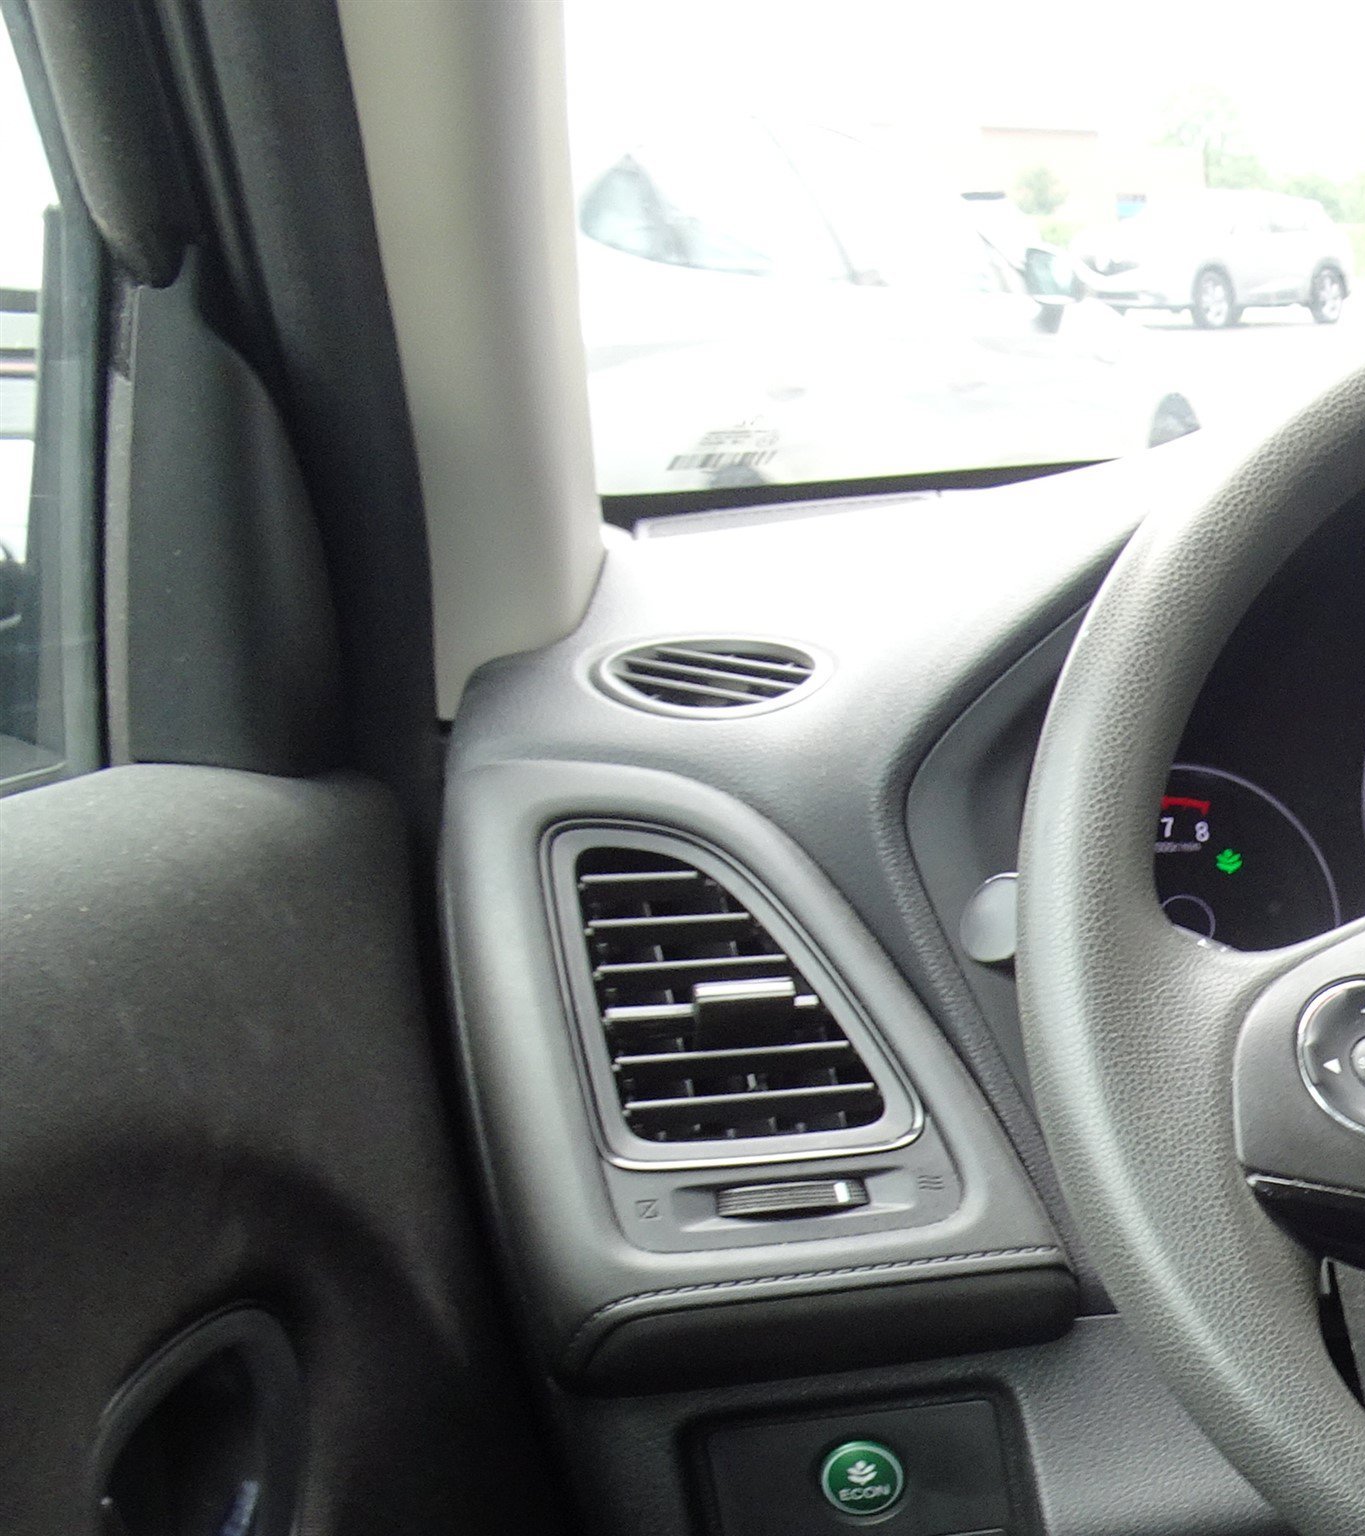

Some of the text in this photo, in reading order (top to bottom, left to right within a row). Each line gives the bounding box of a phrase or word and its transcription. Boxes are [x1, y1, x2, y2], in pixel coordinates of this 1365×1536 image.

[1160, 816, 1210, 842] 7 8
[838, 1483, 891, 1502] ECON
